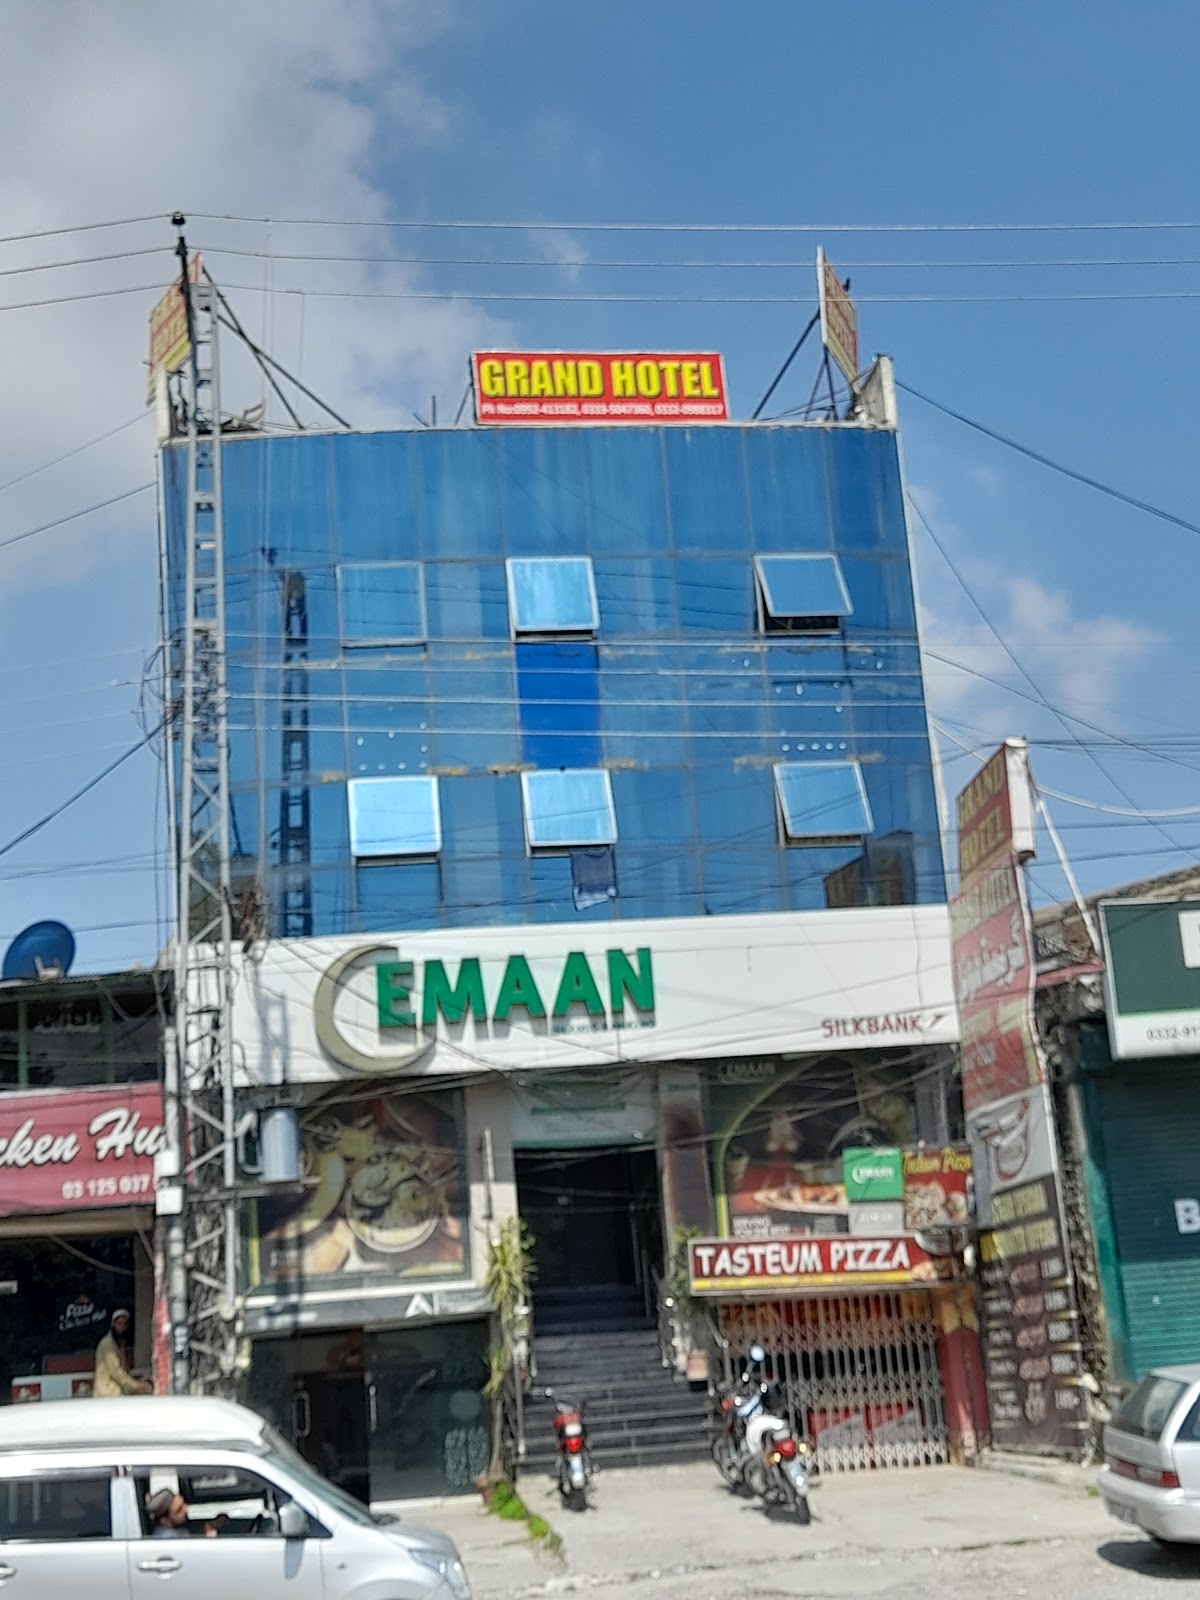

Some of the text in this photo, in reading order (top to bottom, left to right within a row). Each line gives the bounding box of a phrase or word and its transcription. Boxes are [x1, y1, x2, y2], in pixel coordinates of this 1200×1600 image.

[480, 359, 720, 398] GRAND HOTEL
[376, 947, 656, 1029] EMAAN
[822, 1014, 924, 1038] SILKBANK
[695, 1239, 911, 1277] TASTEUM PIZZA
